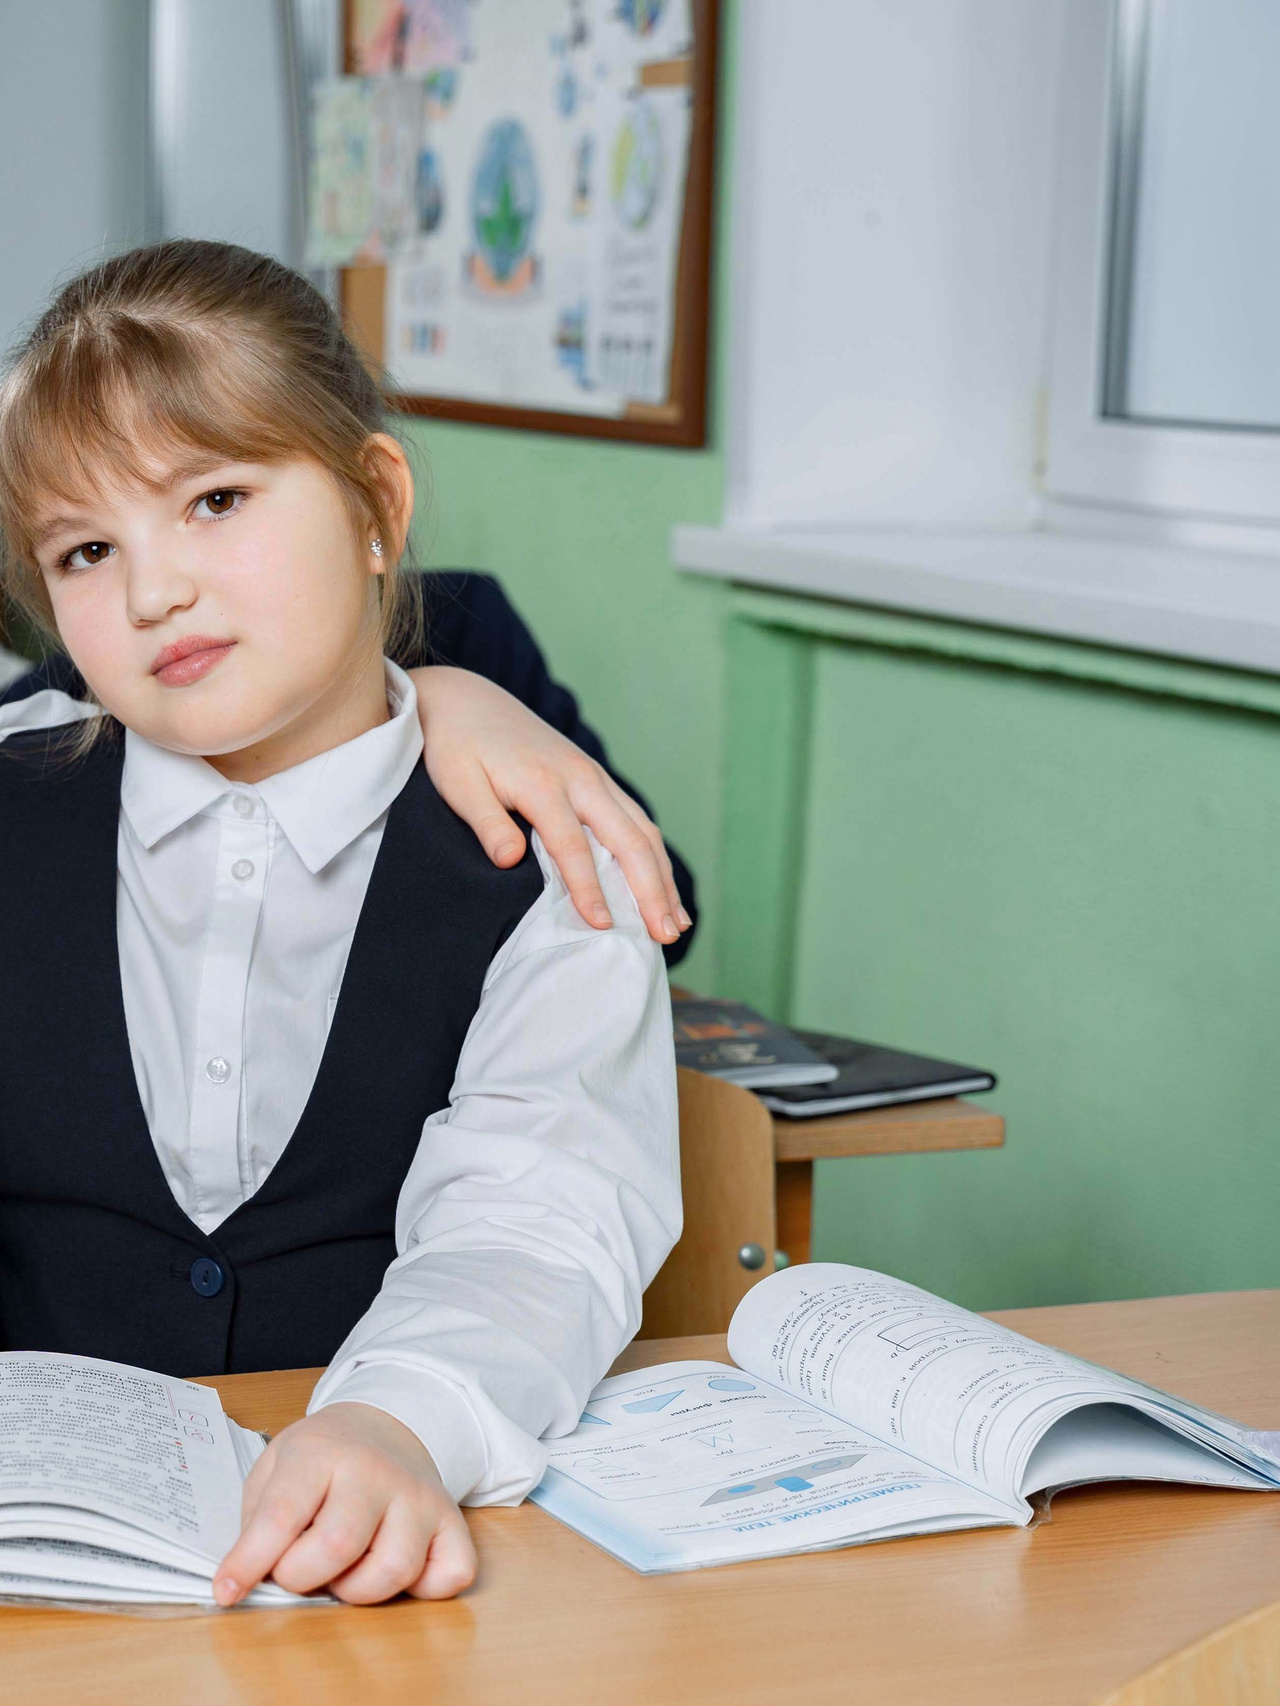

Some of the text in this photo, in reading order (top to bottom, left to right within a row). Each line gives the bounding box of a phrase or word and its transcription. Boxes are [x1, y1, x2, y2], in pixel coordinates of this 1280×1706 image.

[790, 1298, 825, 1328] Проведи
[816, 1297, 855, 1322] покупку?
[839, 1312, 851, 1320] 10
[869, 1310, 888, 1318] или
[809, 1320, 827, 1341] раза
[809, 1323, 834, 1361] стульев.
[779, 1332, 790, 1360] через
[908, 1343, 948, 1371] Построй
[821, 1353, 834, 1381] Реши
[891, 1388, 900, 1409] ней
[956, 1369, 999, 1400] разность.
[990, 1381, 1029, 1409] системе
[670, 1402, 712, 1417] фигуры
[732, 1482, 923, 1532] ГЕОМЕТРИЧЕСКИЕ ТЕЛА
[794, 1490, 839, 1505] которые
